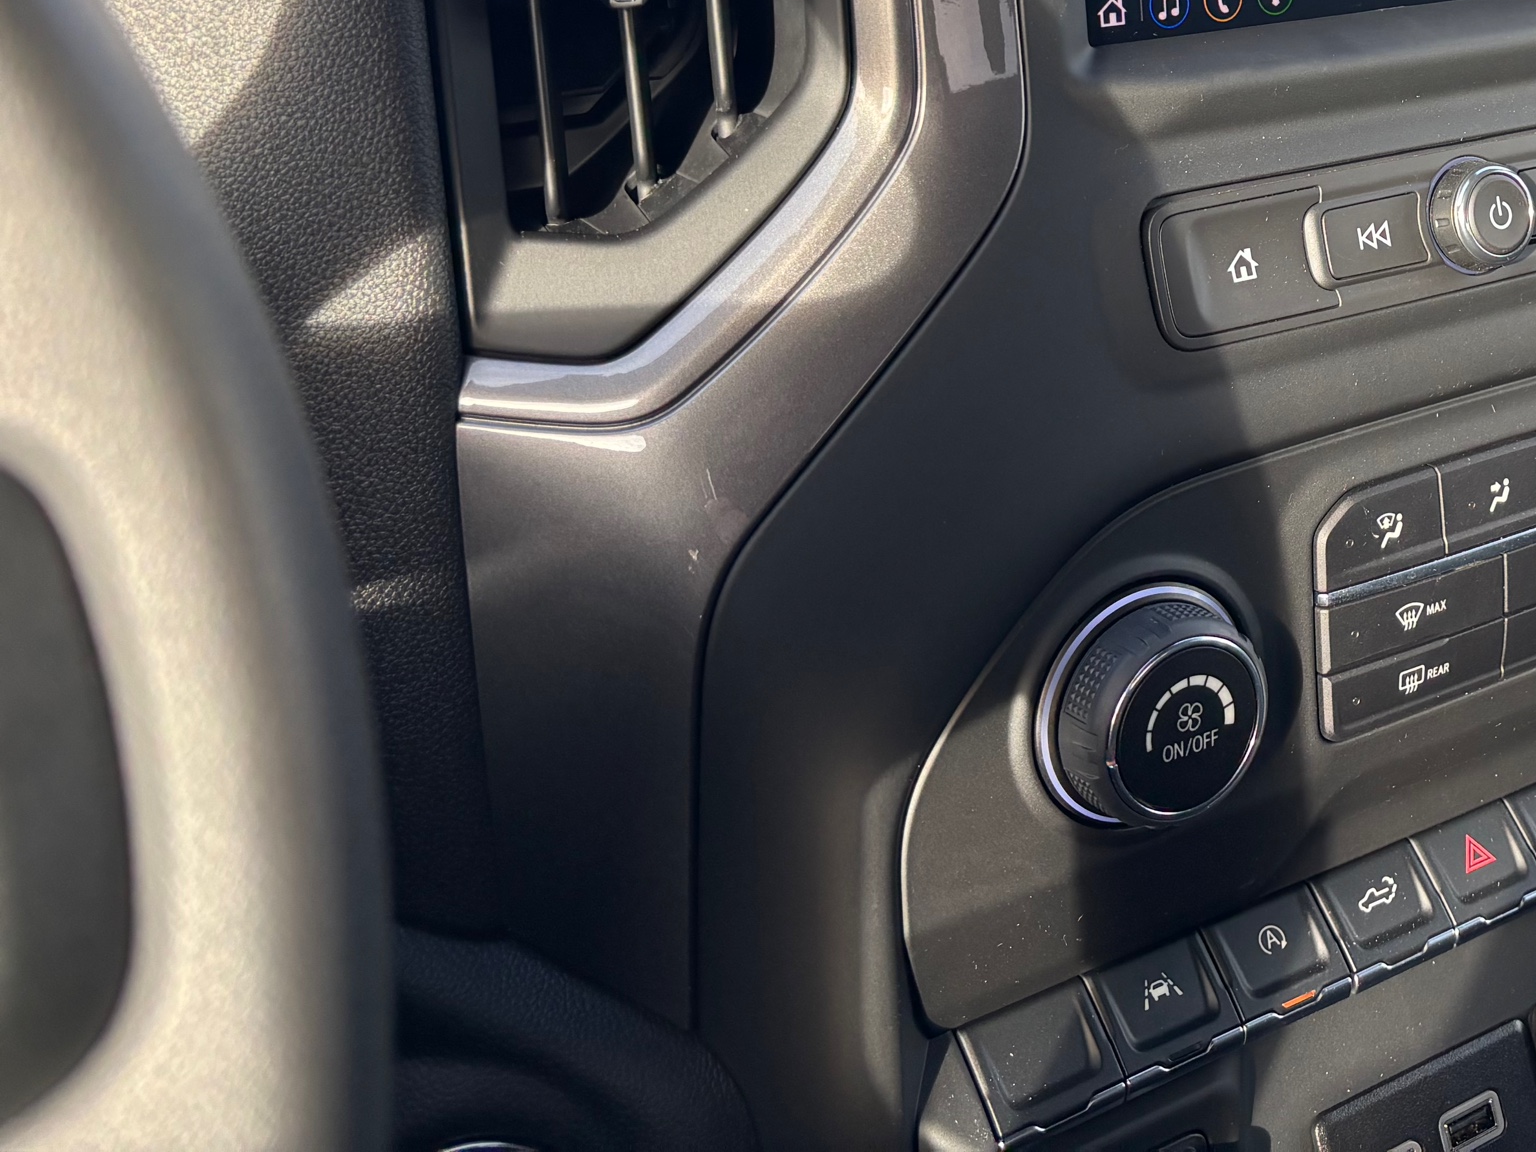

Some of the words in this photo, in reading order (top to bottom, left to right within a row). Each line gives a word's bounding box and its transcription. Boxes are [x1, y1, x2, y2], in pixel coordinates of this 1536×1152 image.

[1426, 599, 1447, 616] MAX
[1426, 662, 1450, 680] REAR
[1162, 728, 1219, 763] ON/OFF
